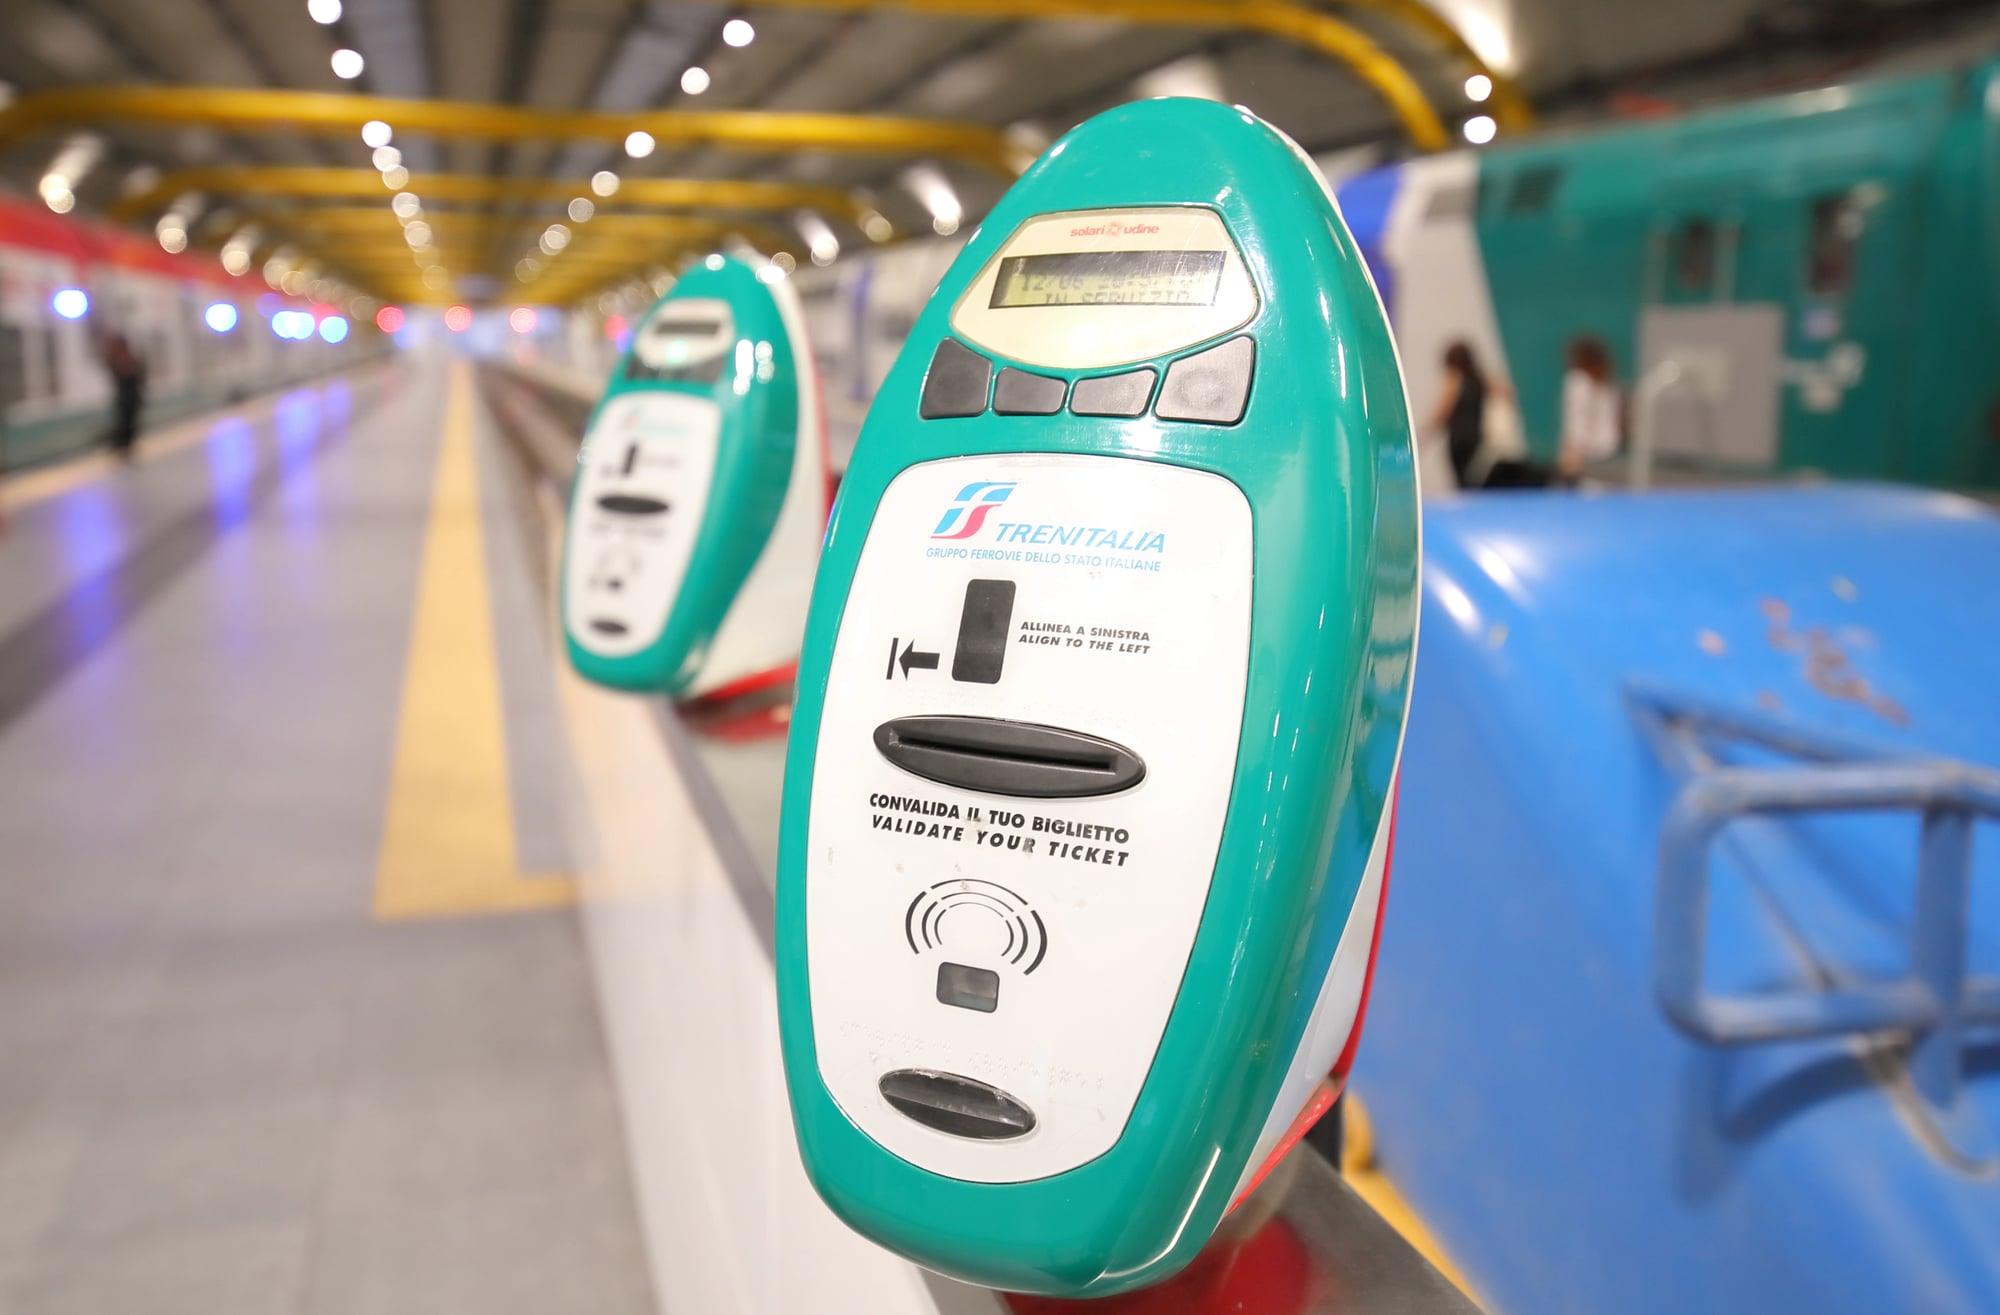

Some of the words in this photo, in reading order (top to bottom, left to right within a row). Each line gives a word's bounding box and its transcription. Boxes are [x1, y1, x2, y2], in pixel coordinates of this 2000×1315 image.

[995, 523, 1166, 553] TRENITALIA
[926, 547, 968, 559] GRUPPO
[971, 549, 1022, 562] FERROVIE
[1025, 551, 1061, 564] DELLO
[1064, 554, 1102, 567] STATO
[1105, 557, 1161, 572] ITALIANE
[1018, 634, 1060, 647] ALIGN
[1065, 638, 1083, 649] TO
[1089, 640, 1114, 651] THE
[1119, 643, 1150, 655] LEFT
[1020, 621, 1071, 634] ALLINEA
[1076, 626, 1085, 636] A
[1090, 627, 1150, 641] SINISTRA
[869, 793, 960, 819] CONVALIDA
[967, 807, 980, 823] IL
[989, 809, 1025, 828] TUO
[1032, 816, 1130, 844] BIGLIETTO
[872, 815, 964, 842] VALIDATE
[976, 830, 1036, 854] YOUR
[1049, 841, 1130, 867] TICKET
